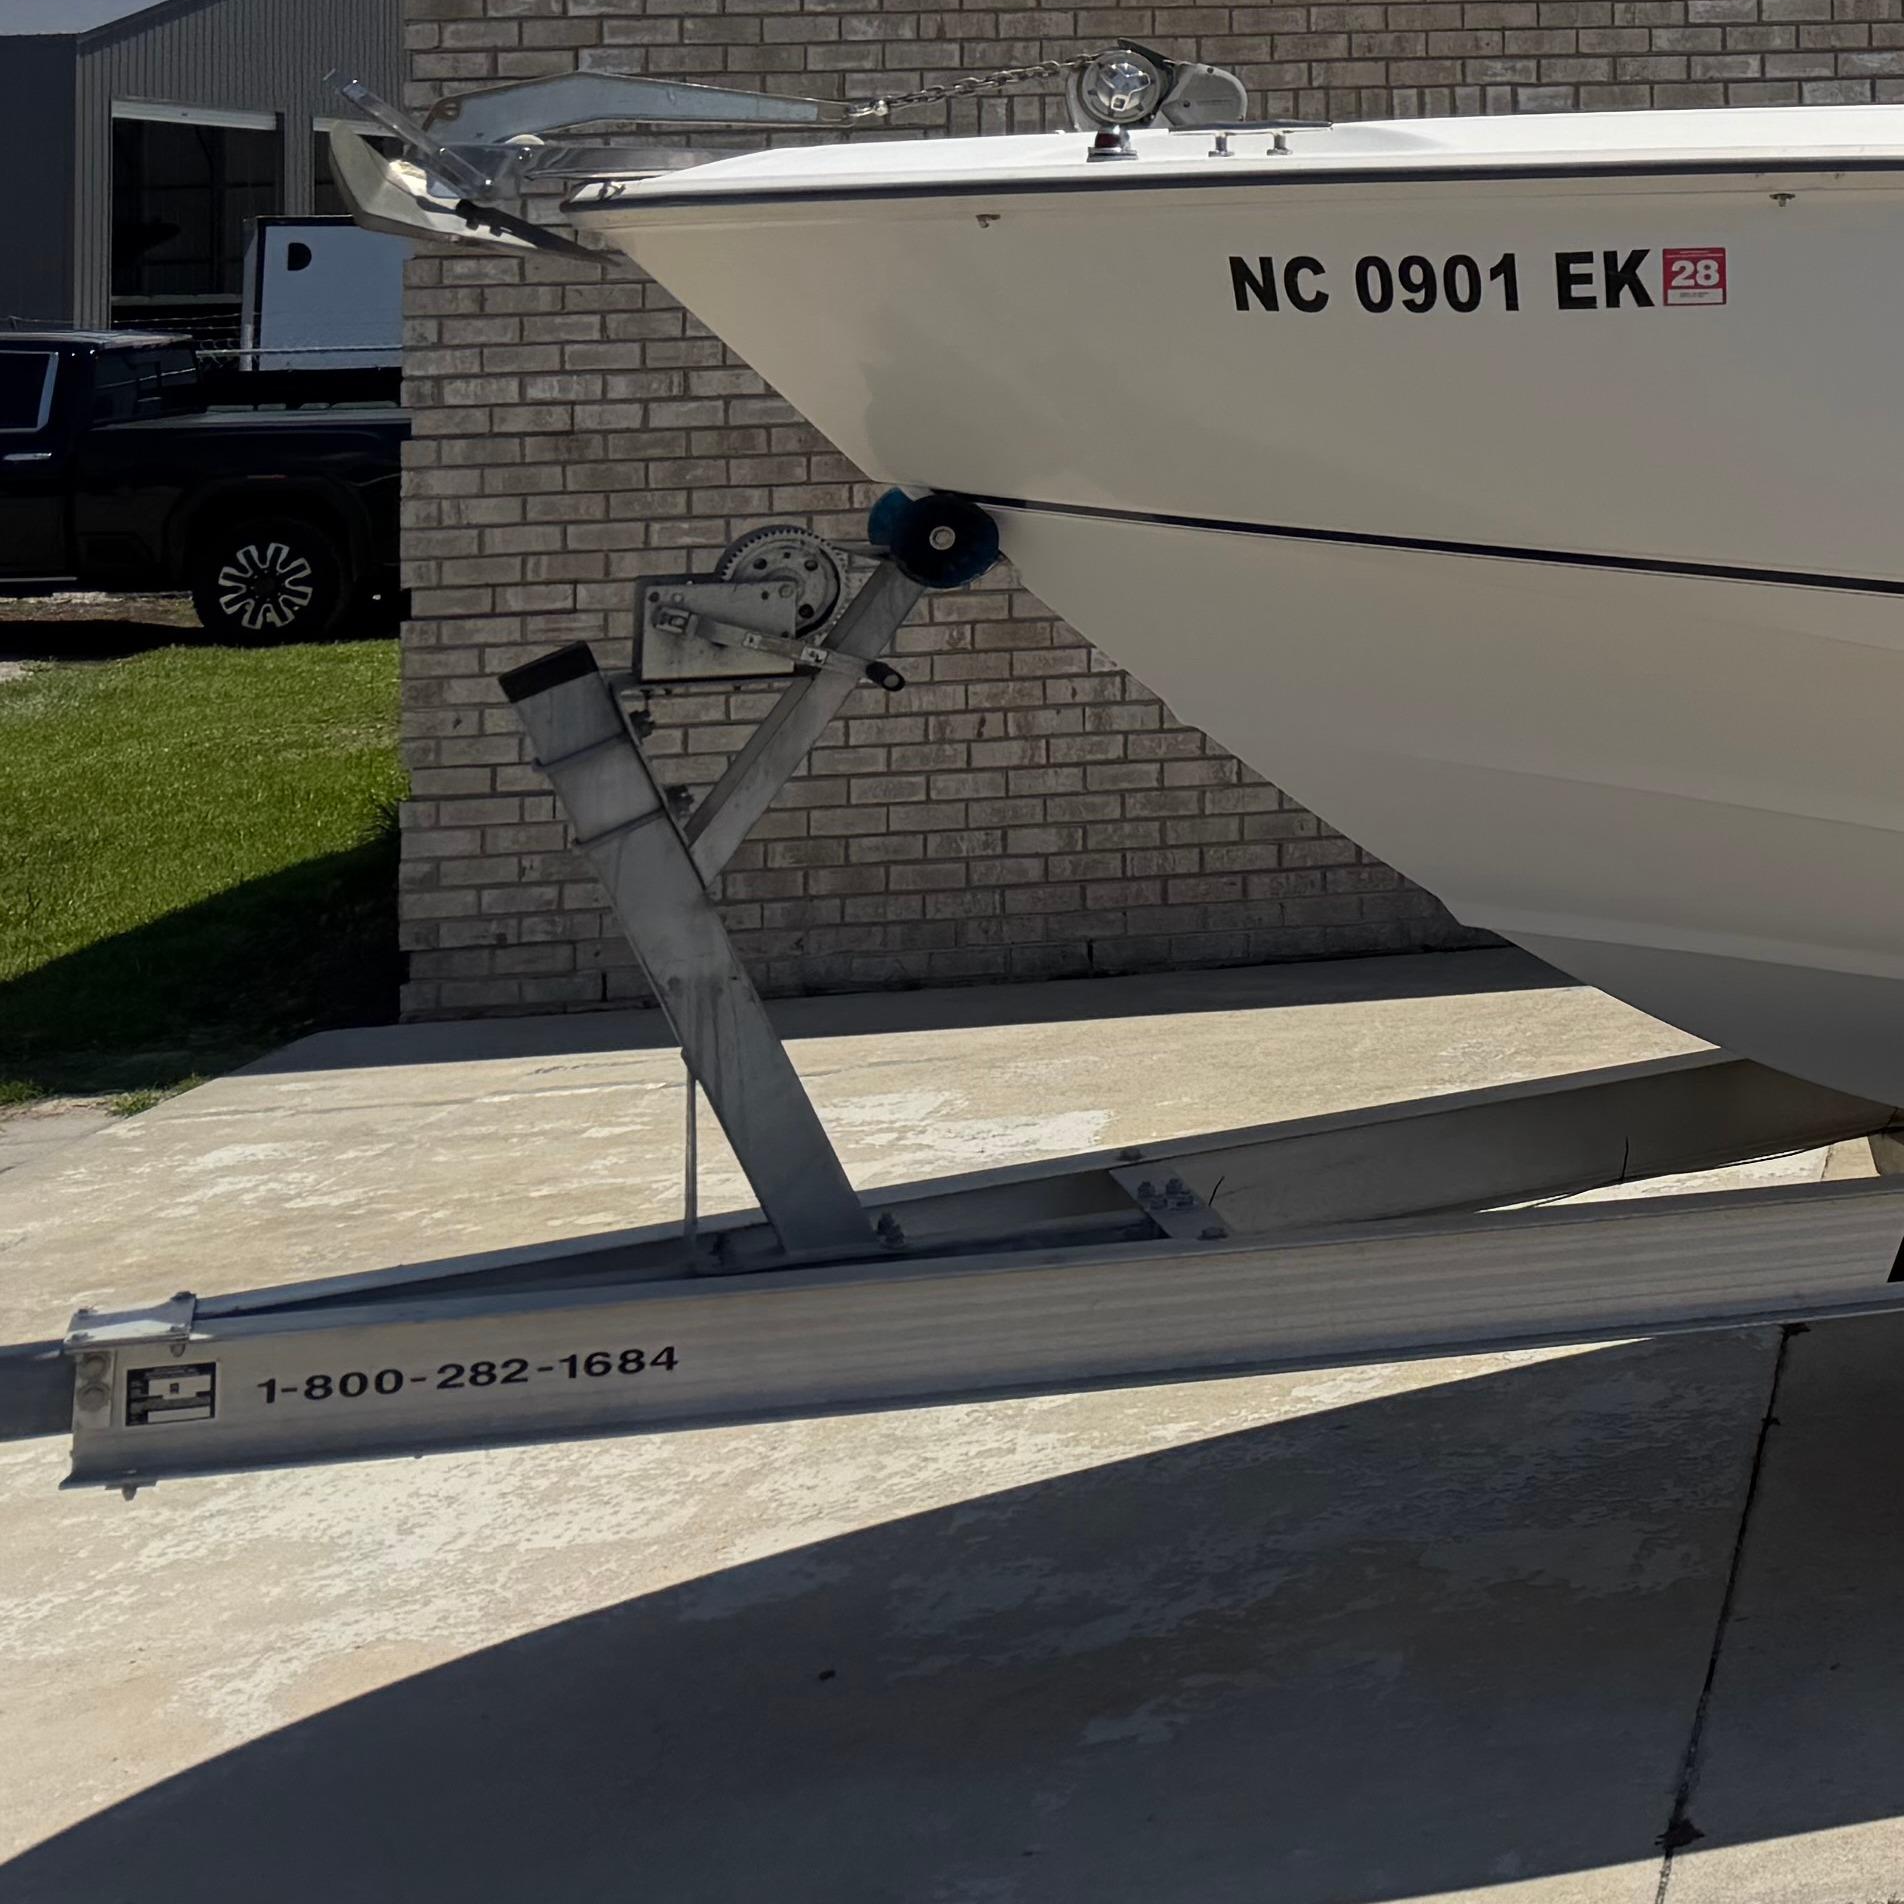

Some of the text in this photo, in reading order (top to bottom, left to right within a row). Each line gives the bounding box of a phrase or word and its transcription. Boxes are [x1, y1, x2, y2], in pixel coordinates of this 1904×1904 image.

[1228, 248, 1656, 314] NC 0901 EK
[1671, 259, 1720, 287] 28
[257, 1345, 679, 1405] 1-800-282-1684
